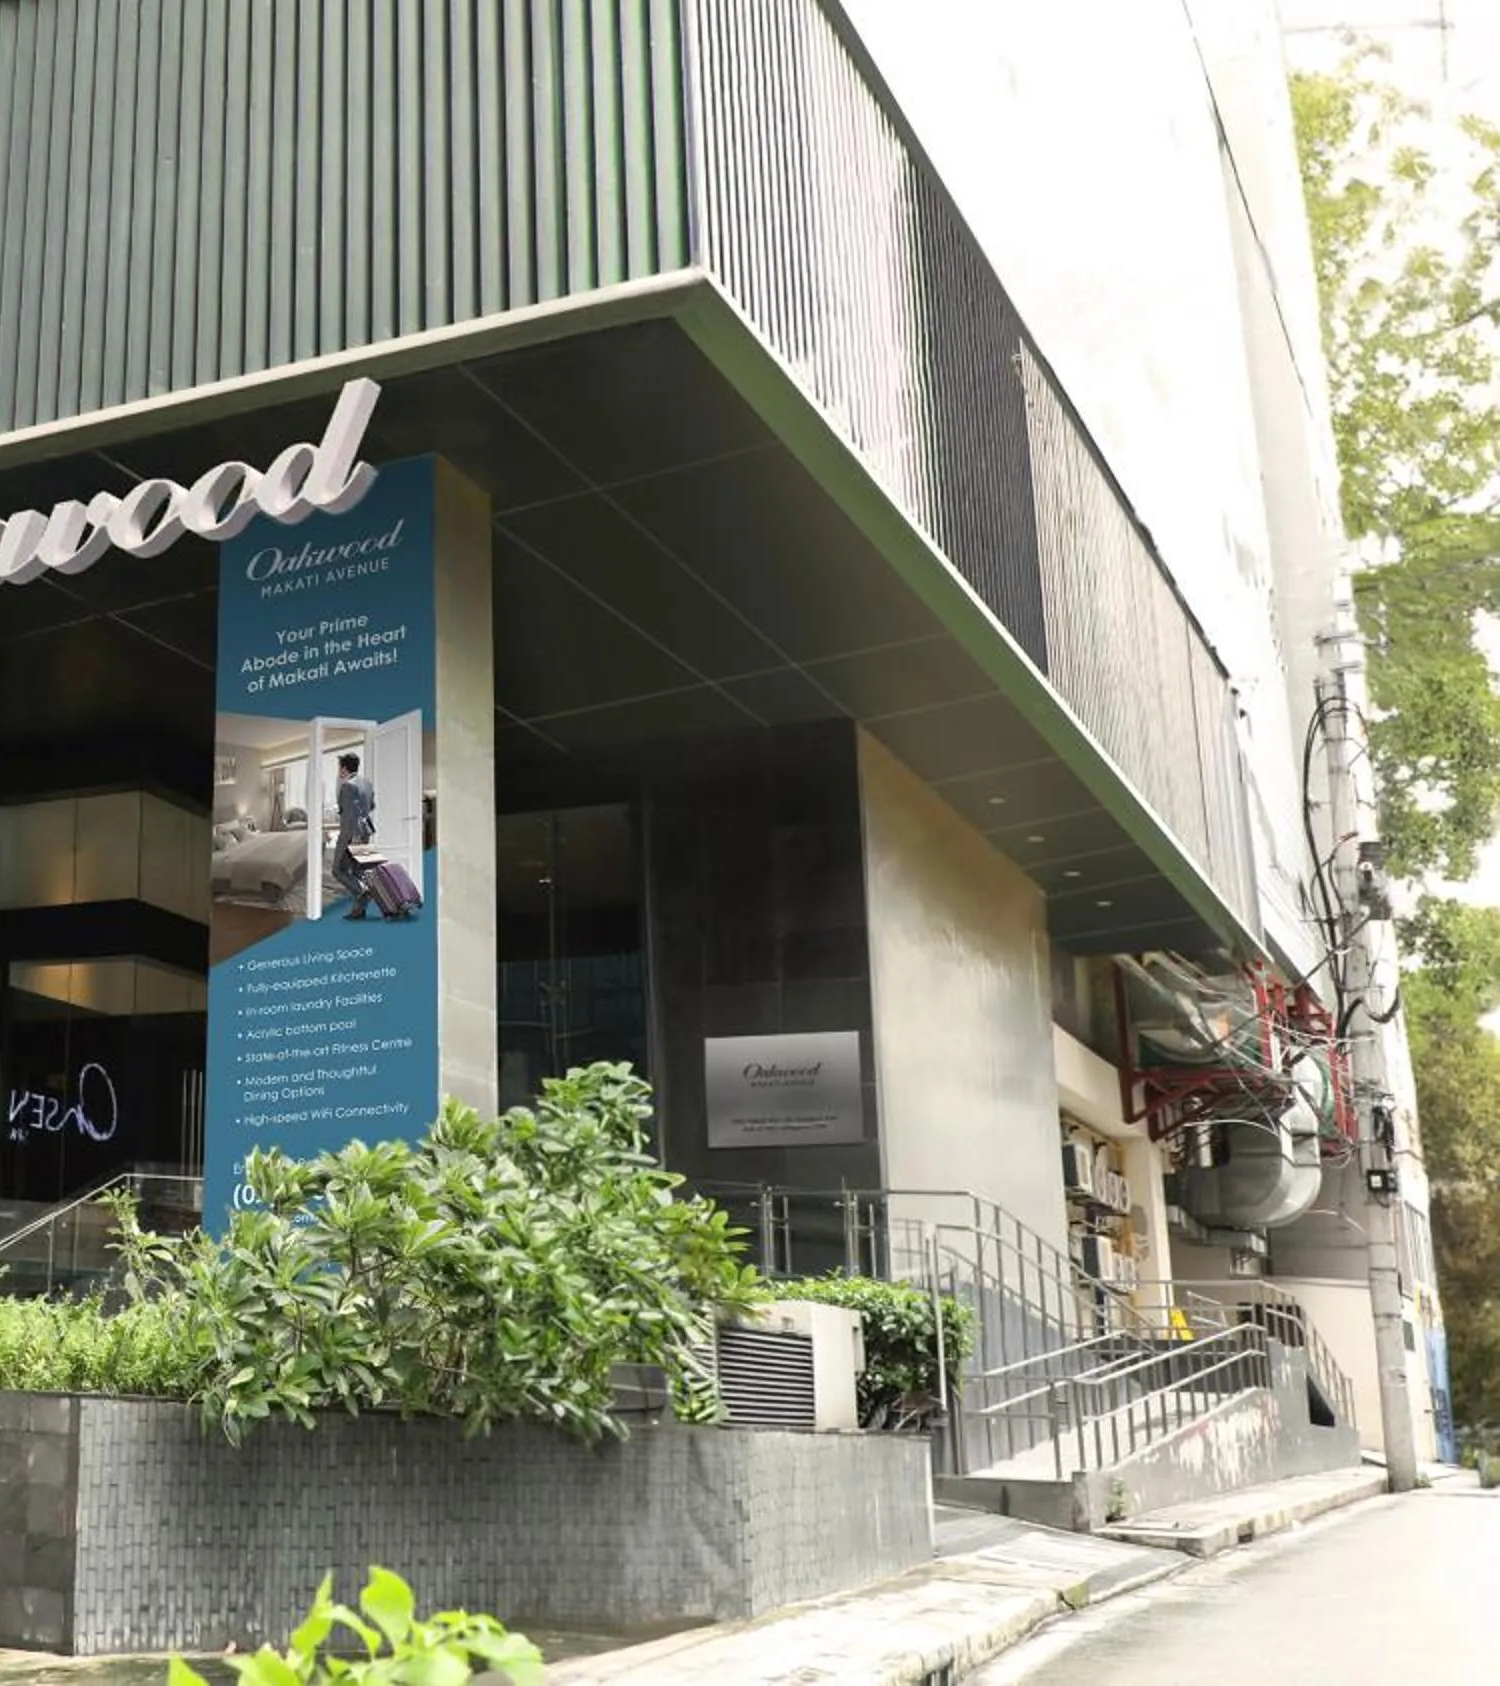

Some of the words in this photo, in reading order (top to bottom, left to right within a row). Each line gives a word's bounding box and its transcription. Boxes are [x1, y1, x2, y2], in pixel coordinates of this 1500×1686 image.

[246, 519, 404, 580] Oakwood
[260, 575, 319, 599] MAKATI
[326, 556, 389, 583] AVENUE
[276, 626, 314, 645] Your
[319, 614, 369, 636] Prime
[241, 650, 299, 673] Abode
[304, 645, 319, 659] in
[324, 637, 352, 656] the
[357, 625, 406, 649] Heart
[246, 676, 264, 693] of
[269, 663, 329, 690] Makati
[334, 648, 398, 675] Awaits!
[247, 956, 300, 972] Generous
[303, 951, 334, 966] Living
[337, 946, 373, 961] Space
[246, 975, 328, 994] Fully-equipped
[331, 967, 397, 984] Kitchenette
[291, 997, 333, 1011] laundry
[335, 991, 383, 1007] Facilities
[245, 1028, 283, 1041] Acrylic
[286, 1021, 328, 1036] bottom
[329, 1019, 357, 1032] pool
[332, 1041, 369, 1056] Fitness
[372, 1036, 413, 1051] Centre
[244, 1071, 289, 1087] Modern
[292, 1069, 315, 1082] and
[317, 1064, 378, 1081] Thoughtful
[244, 1090, 279, 1103] Dining
[281, 1085, 326, 1100] Options
[335, 1102, 410, 1119] Connectivity
